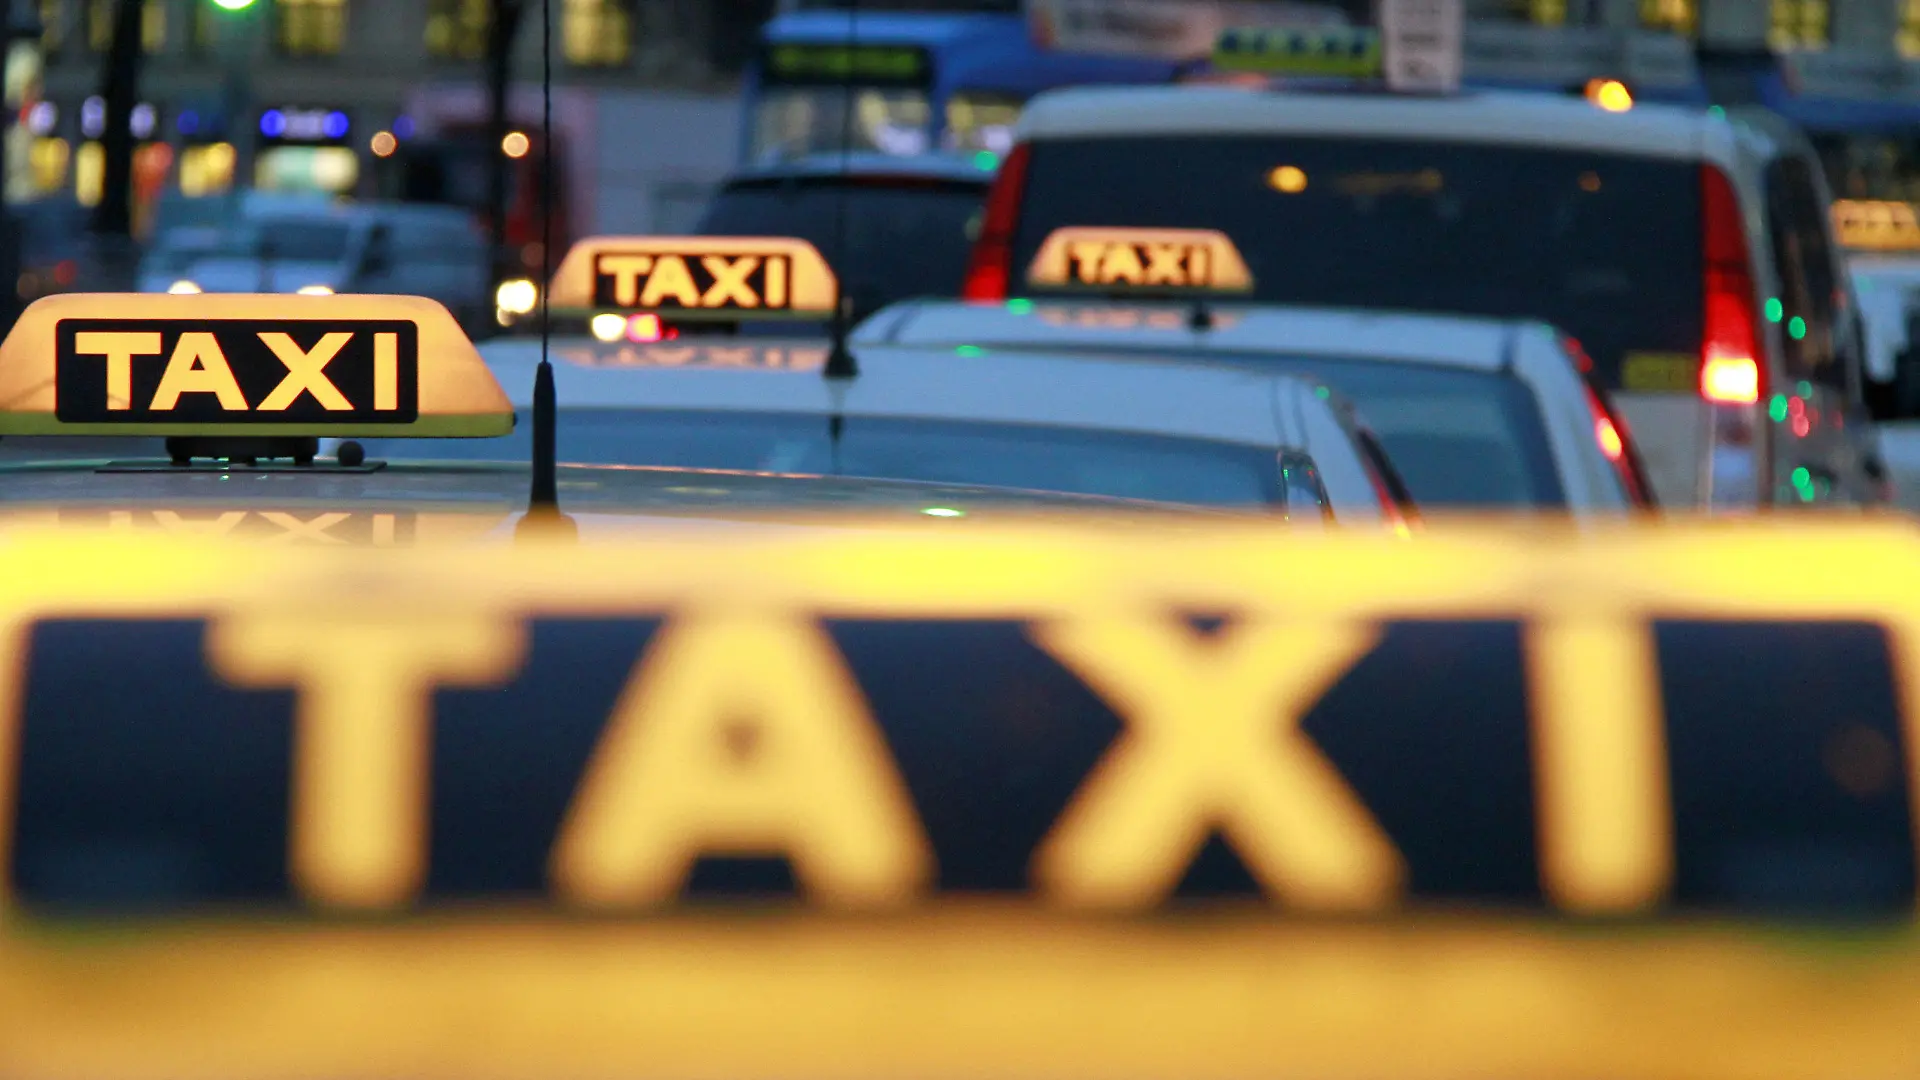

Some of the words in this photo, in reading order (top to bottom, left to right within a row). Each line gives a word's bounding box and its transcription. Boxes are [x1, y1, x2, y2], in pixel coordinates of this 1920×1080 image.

[598, 254, 787, 308] TAXI
[1072, 241, 1208, 285] TAXI
[75, 331, 399, 411] TAXI
[205, 612, 1672, 912] TAXI
